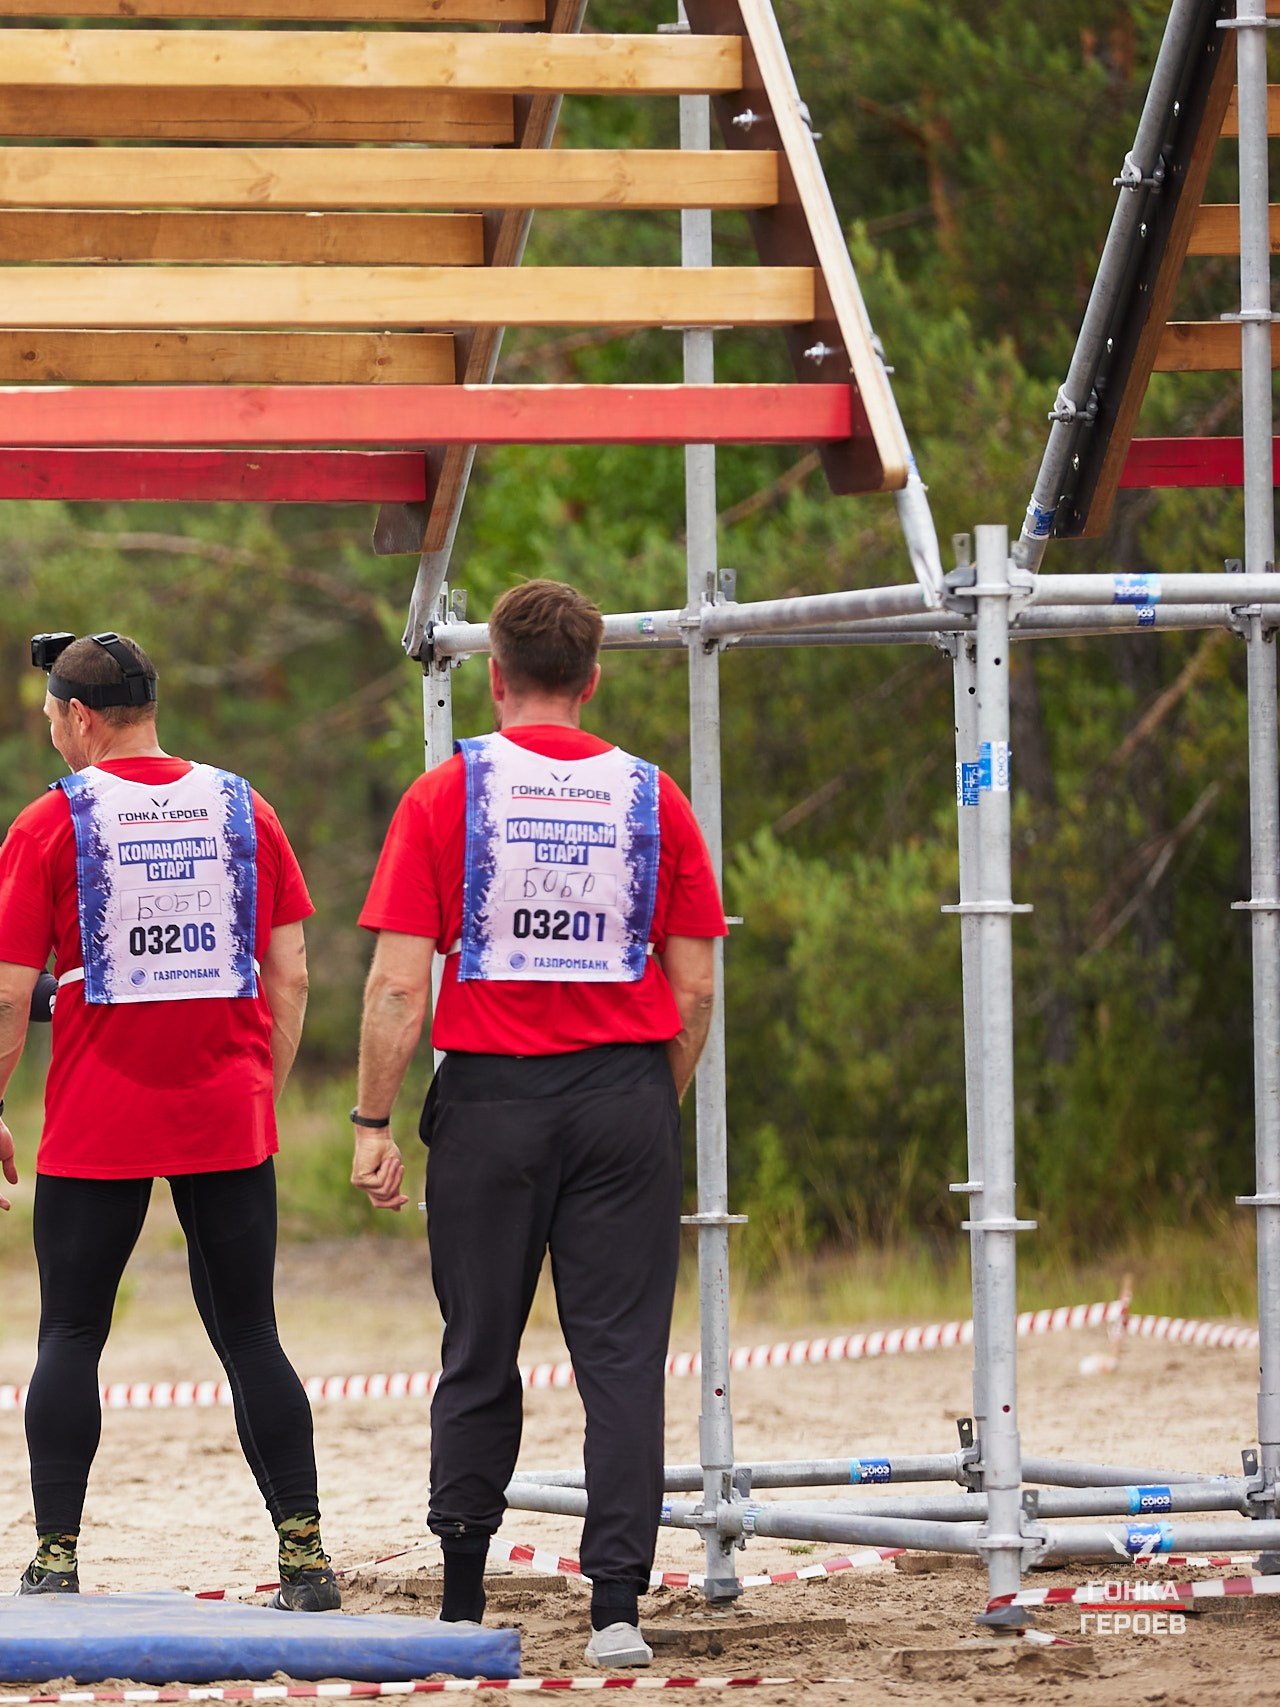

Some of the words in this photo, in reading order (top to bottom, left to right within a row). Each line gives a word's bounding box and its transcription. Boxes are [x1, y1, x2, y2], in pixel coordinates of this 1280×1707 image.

[511, 785, 556, 798] ГОНКА
[561, 787, 612, 801] ГЕРОЕВ
[118, 811, 159, 823] ГОНКА
[162, 808, 209, 821] ГЕРОЕВ
[507, 820, 616, 846] КОМАНДНЫЙ
[120, 837, 216, 863] КОМАНДНЫЙ
[536, 843, 587, 864] СТАРТ
[148, 860, 192, 881] СТАРТ
[137, 889, 212, 921] БОБР
[513, 908, 606, 942] 03201
[129, 922, 217, 957] 03206
[534, 957, 609, 970] ГАЗПРОМБАНК
[153, 968, 221, 982] ГАЗПРОМБАНК
[1141, 1496, 1170, 1506] СОЮЗ
